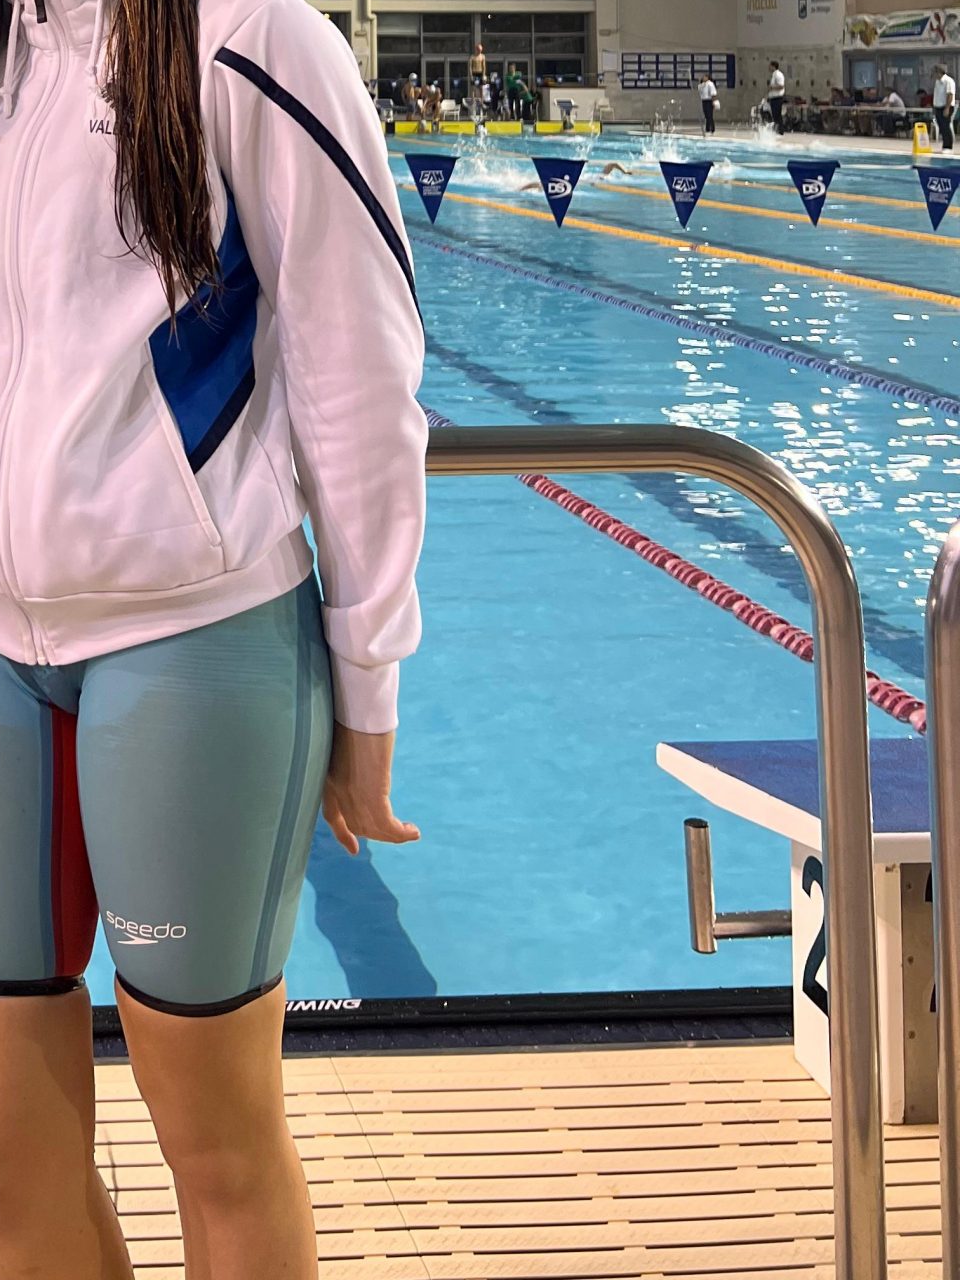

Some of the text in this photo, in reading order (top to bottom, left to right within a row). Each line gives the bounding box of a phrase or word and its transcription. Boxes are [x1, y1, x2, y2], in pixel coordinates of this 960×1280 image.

[89, 119, 116, 136] VAL
[419, 170, 445, 186] FAN
[672, 177, 697, 192] FAN
[927, 176, 952, 192] FAN
[106, 910, 187, 939] speedo
[286, 998, 362, 1011] IMING
